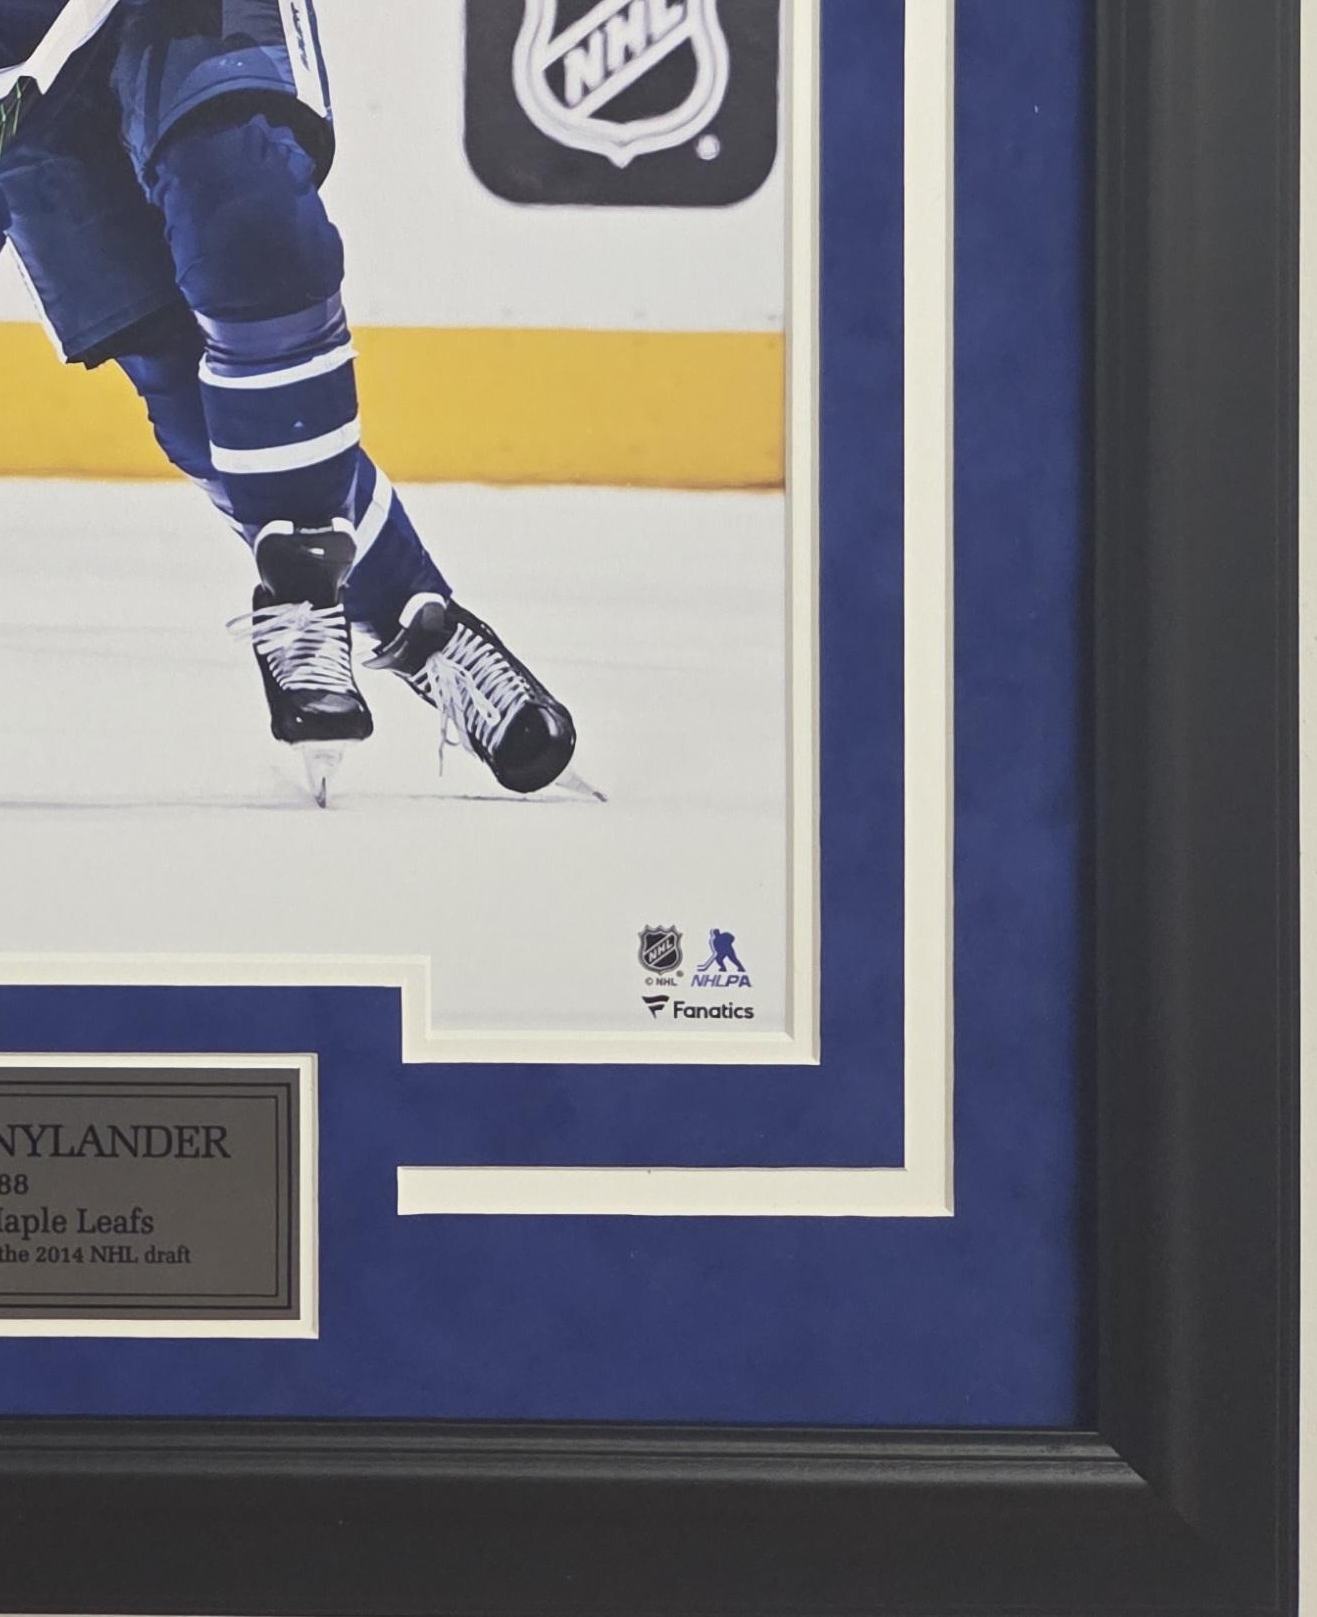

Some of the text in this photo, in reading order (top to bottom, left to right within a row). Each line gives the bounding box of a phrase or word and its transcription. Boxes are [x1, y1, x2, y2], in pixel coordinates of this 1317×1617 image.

[648, 939, 673, 963] NHL
[656, 977, 678, 986] NHL
[690, 974, 752, 988] NHLPA
[673, 1001, 755, 1019] Fanatics
[76, 1206, 154, 1234] Leafs
[35, 1246, 85, 1264] 2014
[89, 1245, 139, 1264] NHL
[143, 1244, 192, 1264] draft
